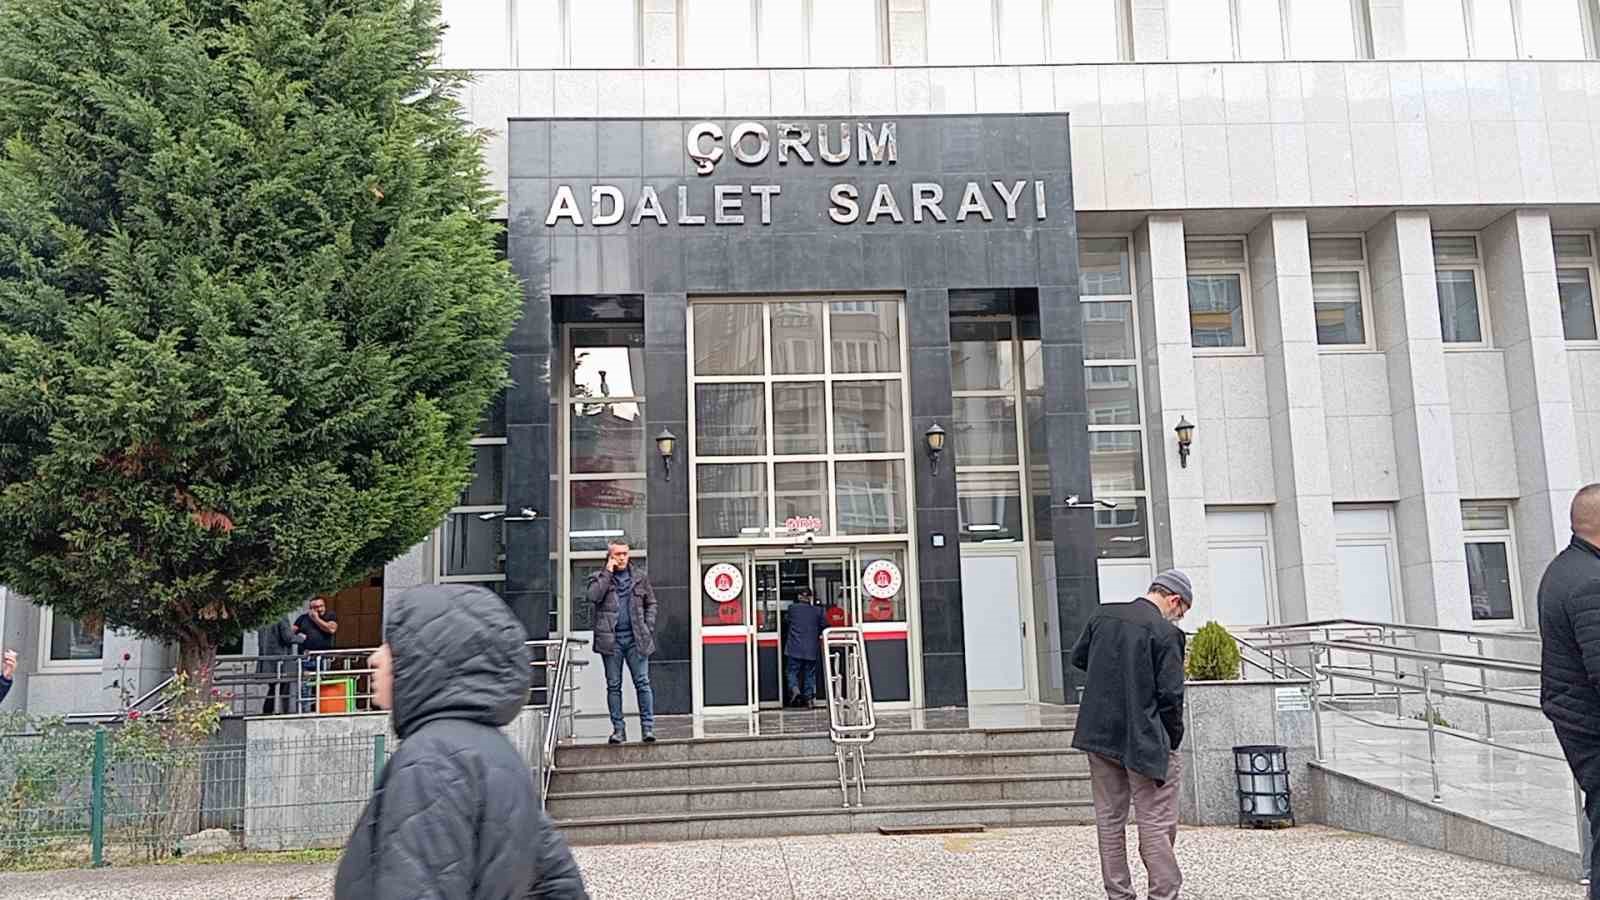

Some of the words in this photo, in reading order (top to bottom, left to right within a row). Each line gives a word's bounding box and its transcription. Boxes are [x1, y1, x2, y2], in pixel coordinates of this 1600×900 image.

[687, 121, 898, 175] ÇORUM
[545, 184, 782, 226] ADALET
[828, 179, 1048, 225] SARAYI
